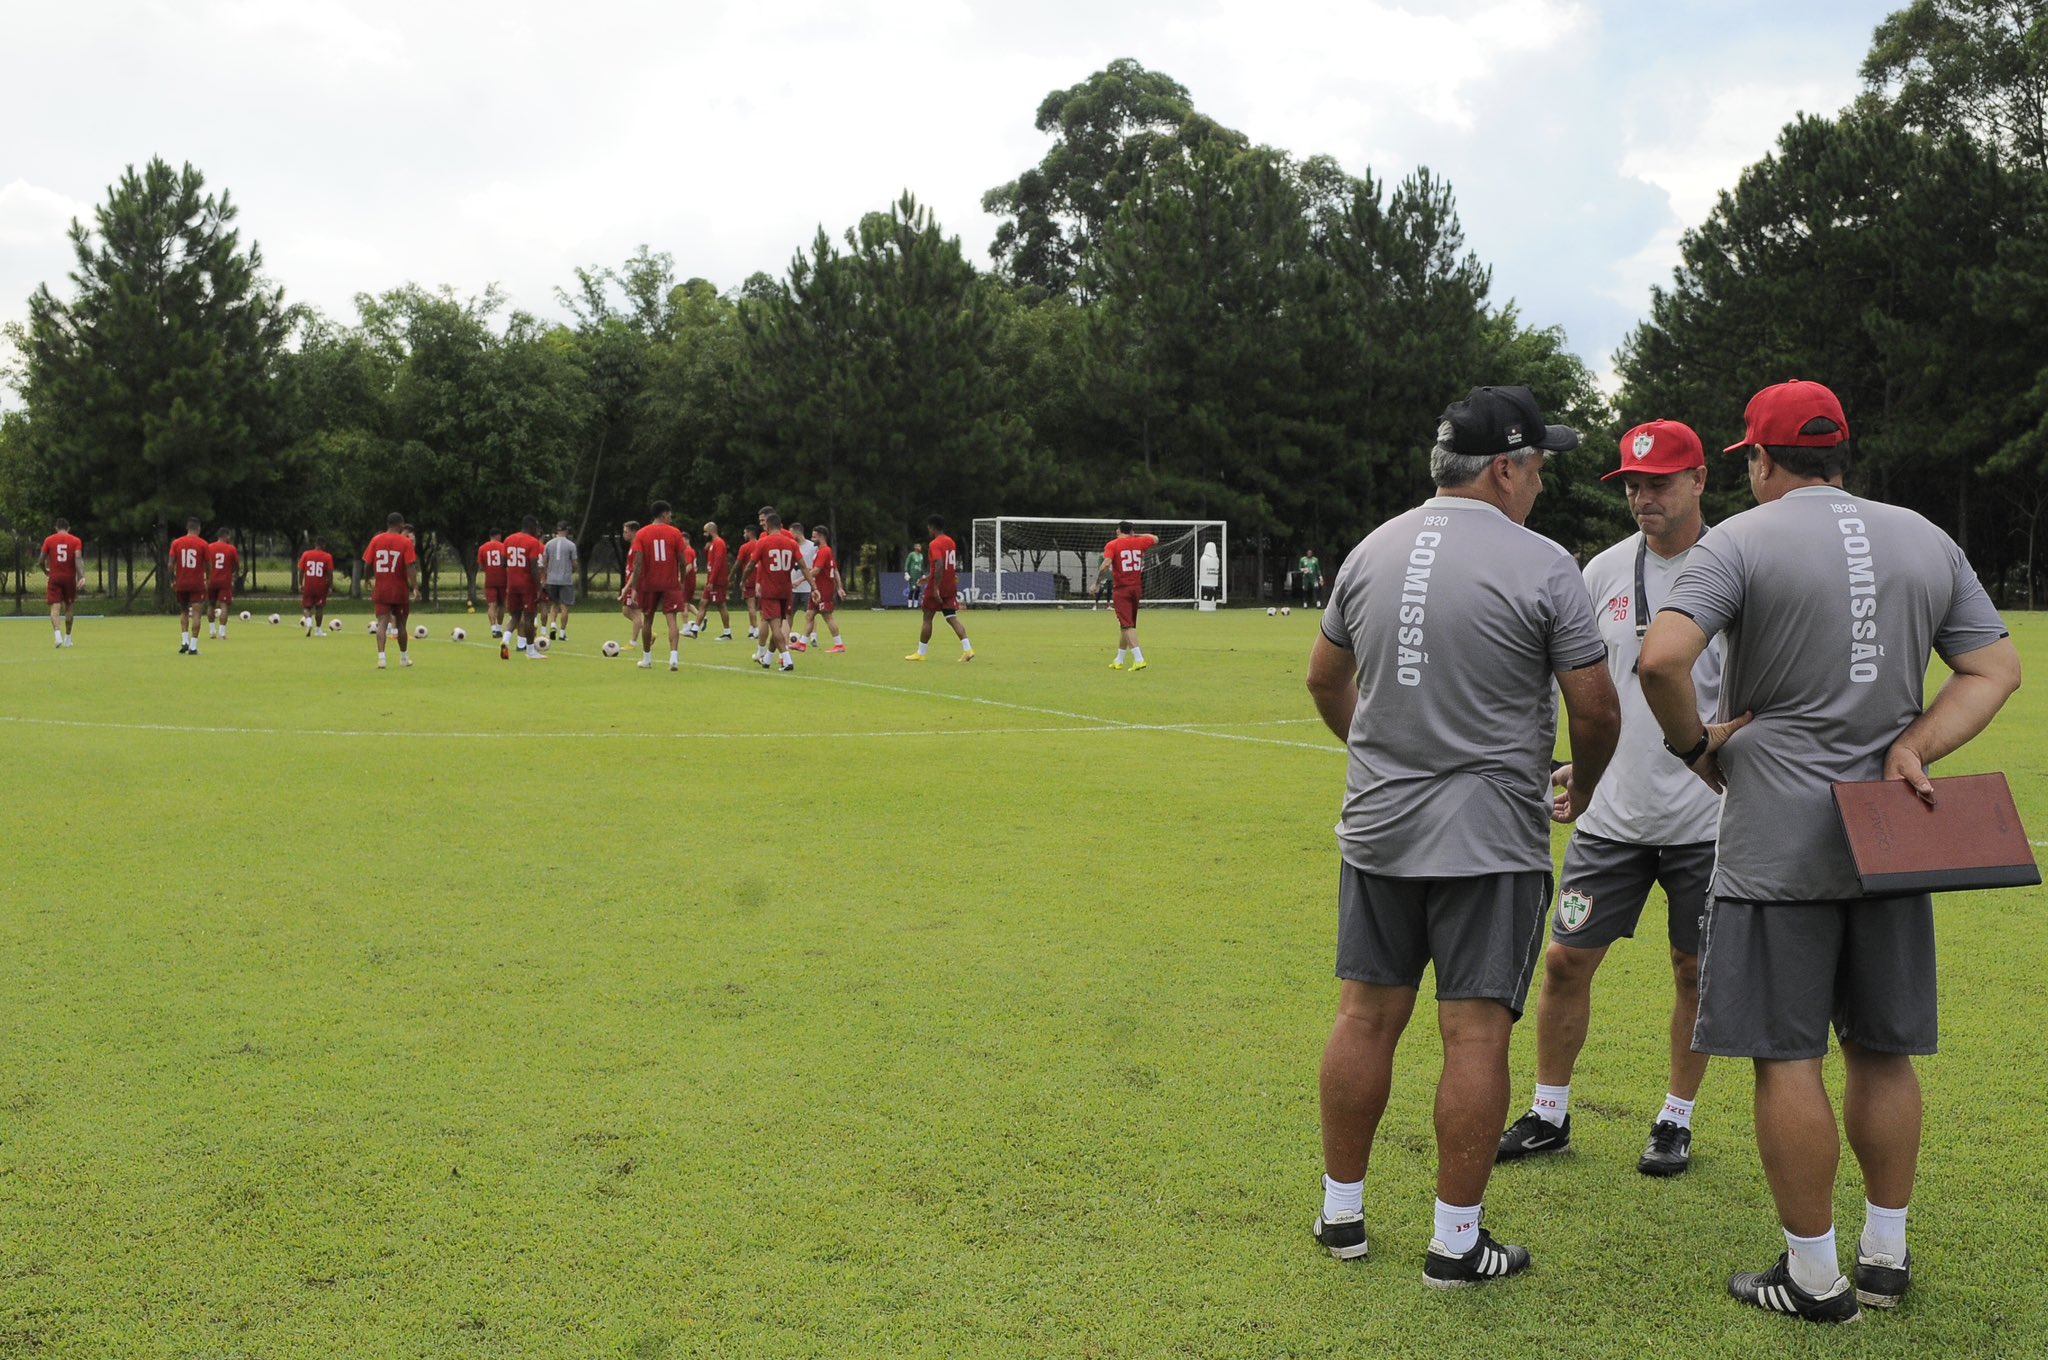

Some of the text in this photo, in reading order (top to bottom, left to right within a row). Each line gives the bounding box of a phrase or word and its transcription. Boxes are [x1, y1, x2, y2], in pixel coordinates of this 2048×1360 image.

[1830, 503, 1858, 514] 1920
[1423, 515, 1449, 527] 1920
[56, 544, 68, 562] 5
[181, 549, 197, 568] 16
[486, 550, 501, 566] 13
[507, 546, 526, 567] 35
[653, 539, 666, 561] 11
[215, 552, 225, 569] 2
[306, 560, 324, 577] 36
[376, 549, 400, 573] 27
[769, 549, 792, 571] 30
[945, 549, 956, 570] 14
[1120, 549, 1141, 572] 25
[982, 590, 1035, 601] CRÉDITO
[1618, 596, 1629, 609] 19
[1838, 517, 1886, 683] COMISSÃO
[1397, 531, 1442, 687] COMISSÃO
[1613, 609, 1627, 621] 20
